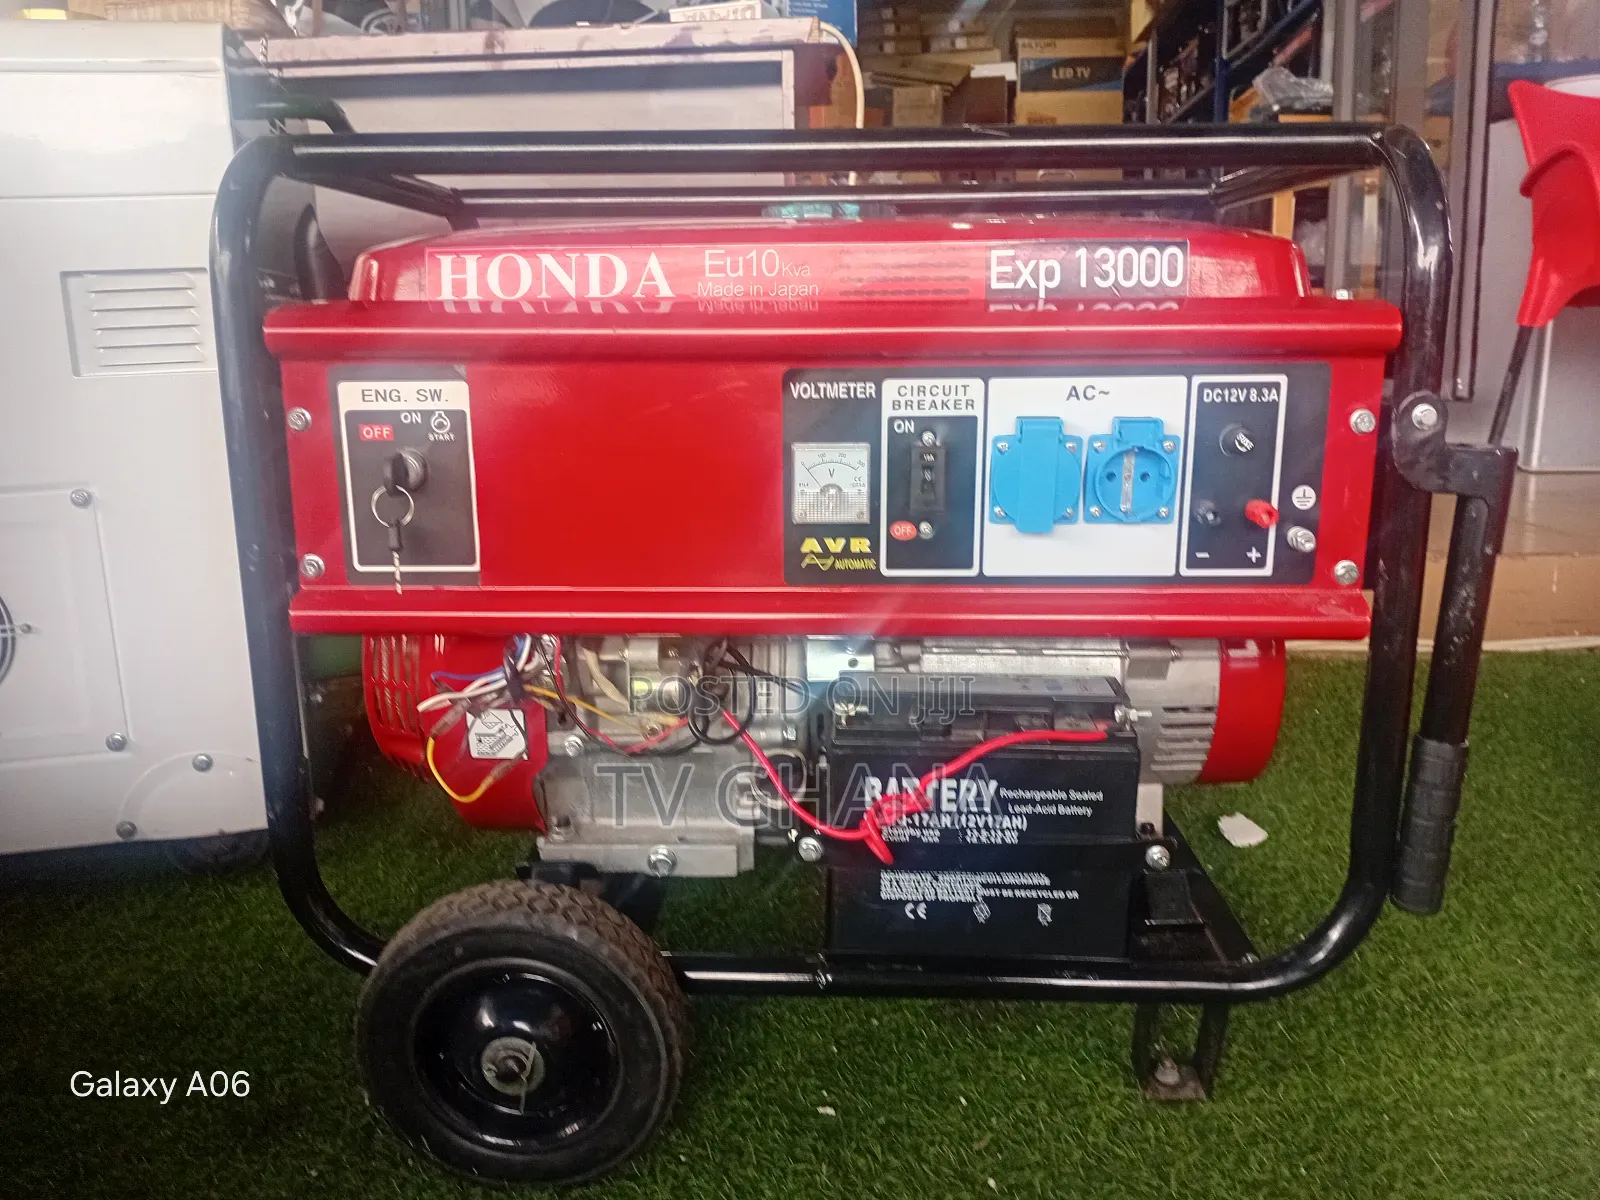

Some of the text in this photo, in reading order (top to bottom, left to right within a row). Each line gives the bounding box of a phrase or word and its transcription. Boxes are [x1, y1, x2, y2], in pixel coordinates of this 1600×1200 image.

[1051, 66, 1092, 79] LED TV
[435, 252, 677, 300] HONDA
[990, 249, 1061, 299] Exp
[1074, 246, 1184, 288] 13000
[697, 281, 819, 299] Made in Japan
[361, 388, 449, 403] ENG. SW.
[790, 381, 876, 399] VOLTMETER
[897, 384, 970, 397] CIRCUIT
[1203, 388, 1279, 403] DC12V 8.3A
[892, 399, 975, 411] BREAKER
[400, 412, 422, 424] ON
[894, 419, 914, 433] ON
[363, 427, 391, 439] OFF
[428, 433, 455, 441] START
[828, 468, 835, 478] V
[894, 525, 912, 536] OFF
[800, 537, 872, 554] AVR
[834, 558, 877, 571] AUTOMATIC
[999, 787, 1068, 802] Rechargeable
